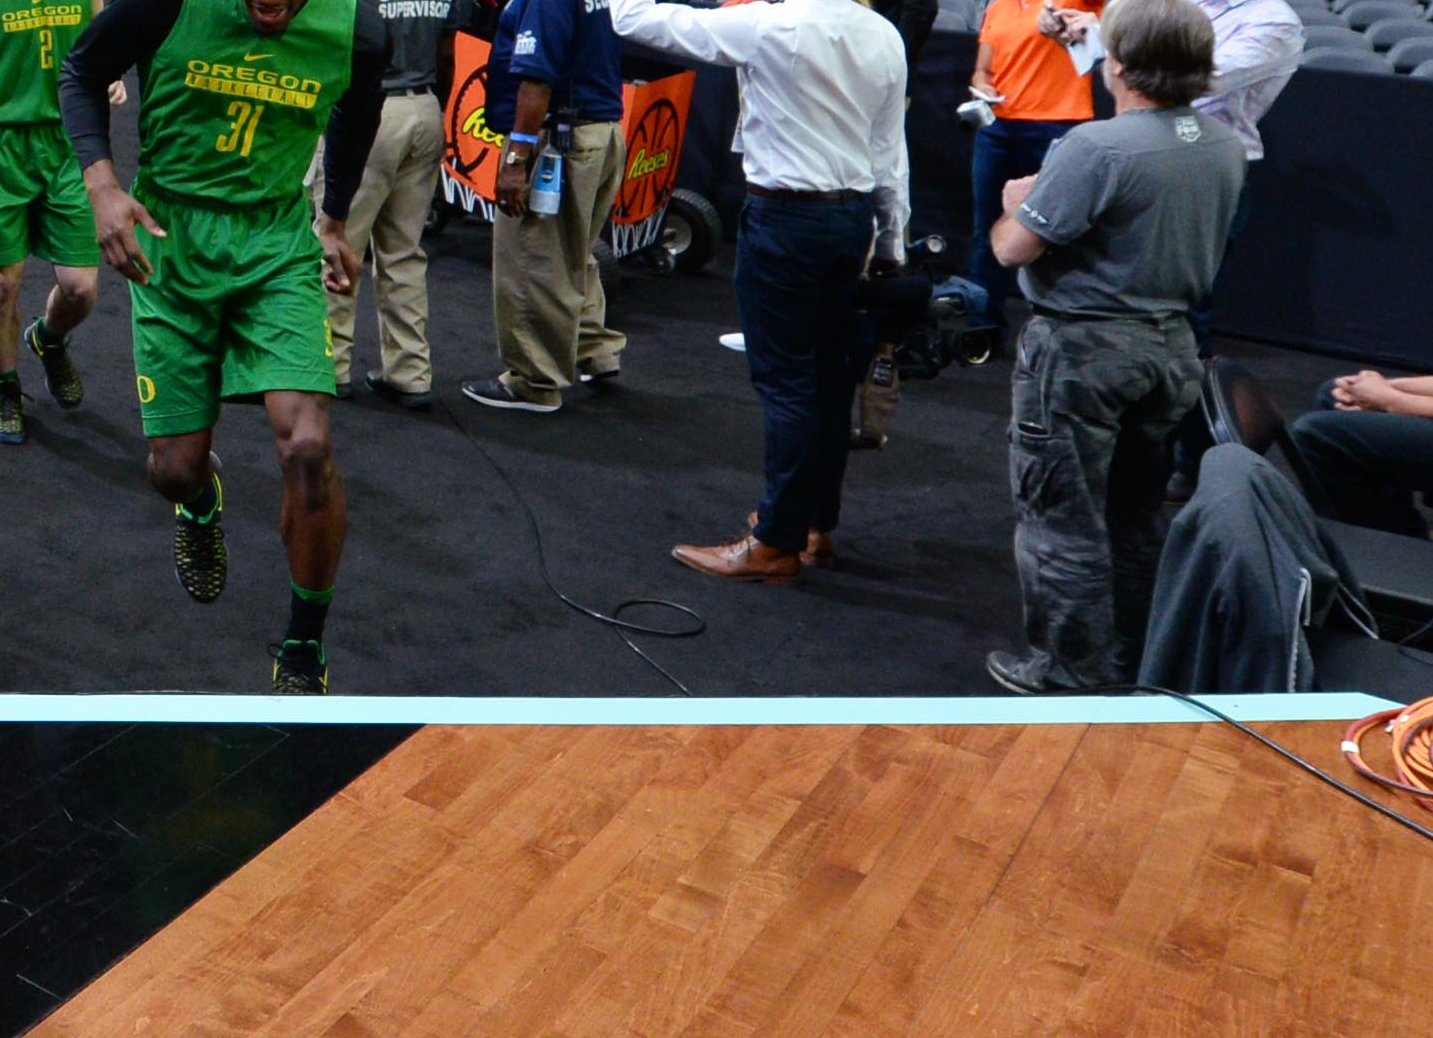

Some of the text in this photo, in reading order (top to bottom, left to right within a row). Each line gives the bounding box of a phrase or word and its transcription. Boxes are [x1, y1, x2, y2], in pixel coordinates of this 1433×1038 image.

[1, 4, 82, 22] OREGON
[378, 0, 451, 19] SUPERVISOR
[187, 60, 322, 94] OREGON
[215, 101, 265, 157] 31
